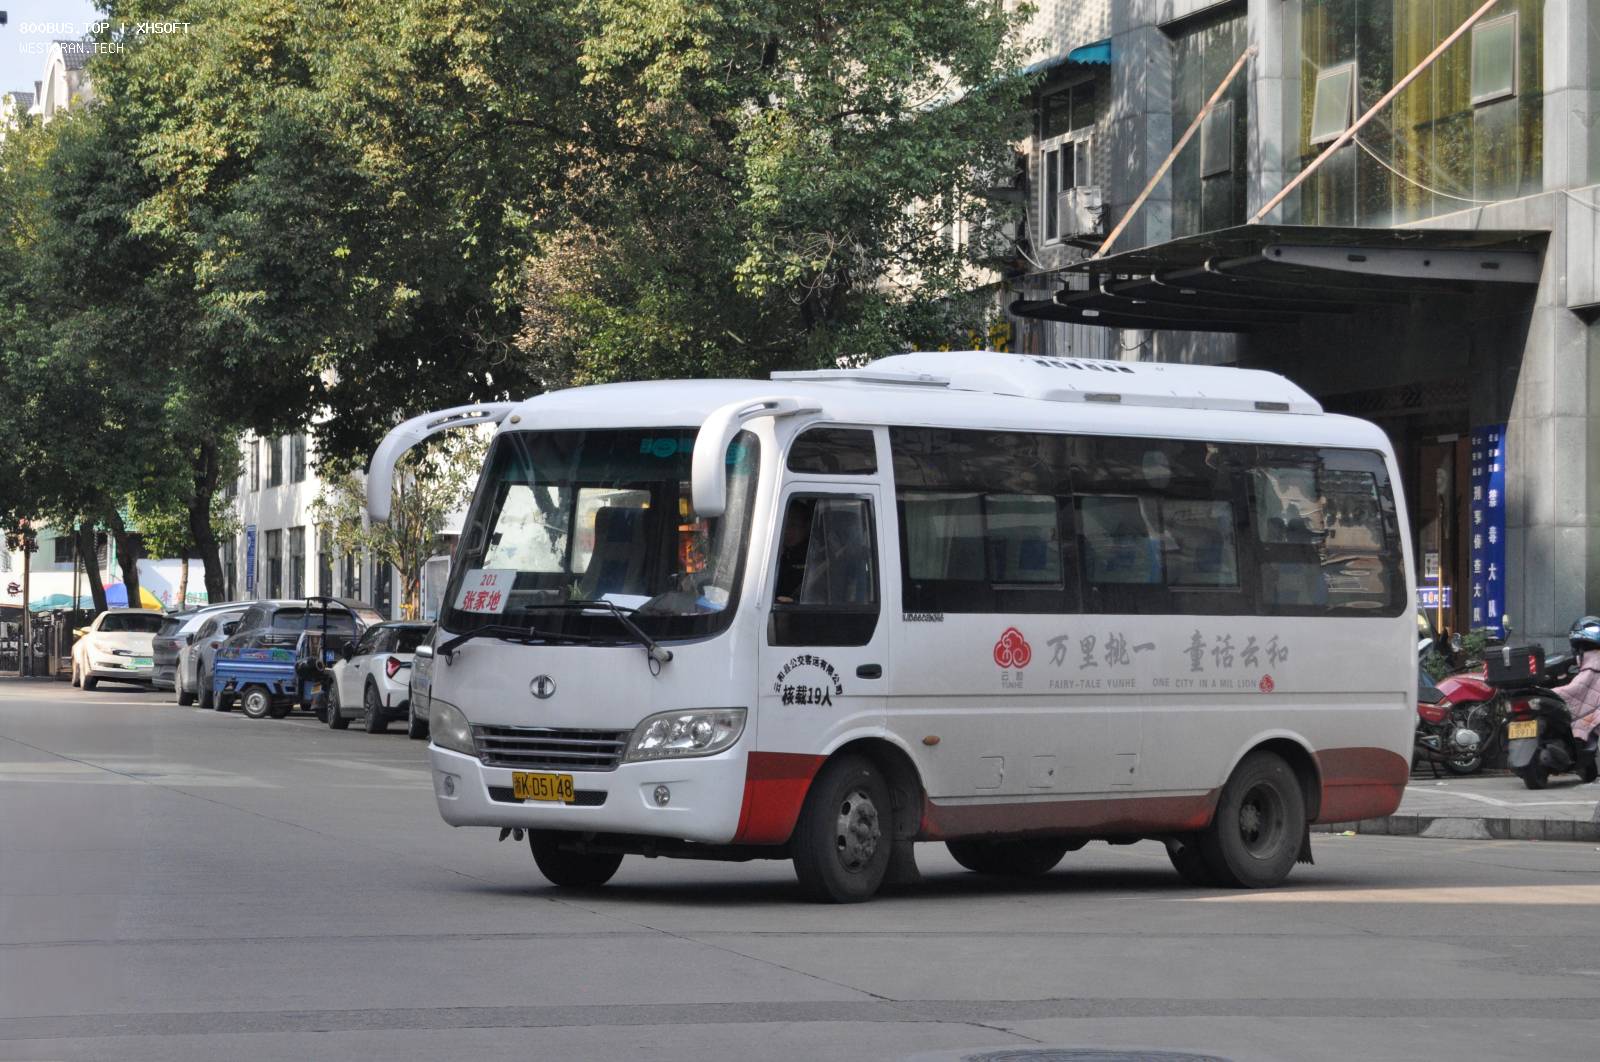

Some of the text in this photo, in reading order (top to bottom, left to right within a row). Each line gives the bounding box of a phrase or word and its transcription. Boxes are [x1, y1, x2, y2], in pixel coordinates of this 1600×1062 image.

[480, 573, 498, 587] 201
[463, 589, 502, 612] 张家地
[1046, 629, 1289, 673] 万里挑一 童话云和
[1049, 679, 1101, 689] FAIRY-TALE
[1152, 678, 1170, 688] ONE
[1175, 679, 1194, 689] CITY
[1199, 679, 1208, 689] IN
[1211, 679, 1217, 689] A
[781, 684, 832, 706] 核载19人
